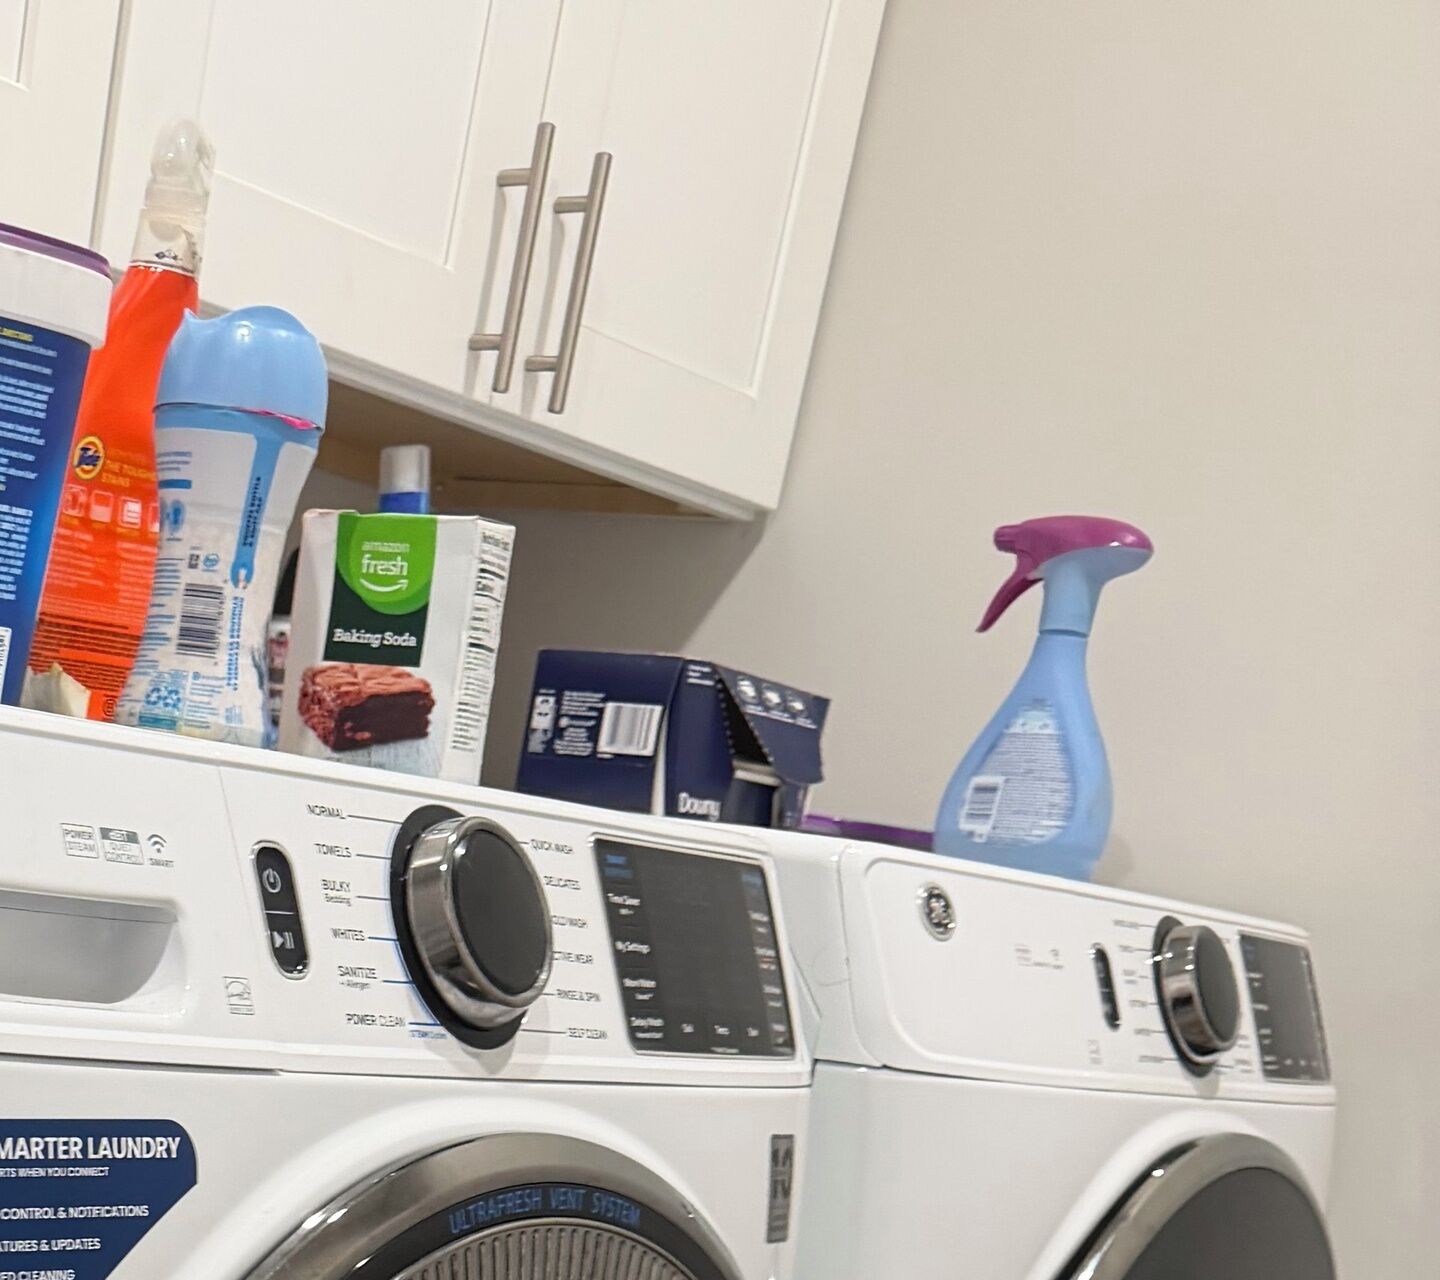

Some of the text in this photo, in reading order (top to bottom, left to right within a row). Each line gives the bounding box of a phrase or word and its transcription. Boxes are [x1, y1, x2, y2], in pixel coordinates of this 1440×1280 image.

[361, 541, 410, 552] amazon
[361, 553, 408, 576] fresh
[332, 628, 417, 648] Baking Soda
[307, 804, 346, 820] NORMAL
[678, 792, 721, 822] Downy
[63, 829, 93, 841] POWER
[314, 843, 352, 858] TOWELS
[530, 838, 553, 852] QUICK
[148, 857, 175, 868] SMART
[321, 879, 351, 893] BULKY
[330, 928, 365, 942] WHITES
[551, 950, 574, 963] CTIVE
[337, 965, 378, 980] SANITIZE
[345, 1013, 406, 1028] POWER CLEAN
[568, 1027, 608, 1040] SELF CLEAN
[87, 1136, 181, 1159] LAUNDRY
[17, 1167, 47, 1177] WHEN
[46, 1167, 66, 1177] YOU
[66, 1166, 109, 1177] CONNECT
[0, 1206, 56, 1220] CONTROL
[57, 1206, 67, 1219] &
[68, 1205, 149, 1219] NOTIFICATIONS
[448, 1188, 642, 1235] ULTRAFRESH VENT SYSTEM
[39, 1239, 50, 1251] &
[51, 1238, 101, 1251] UPDATES
